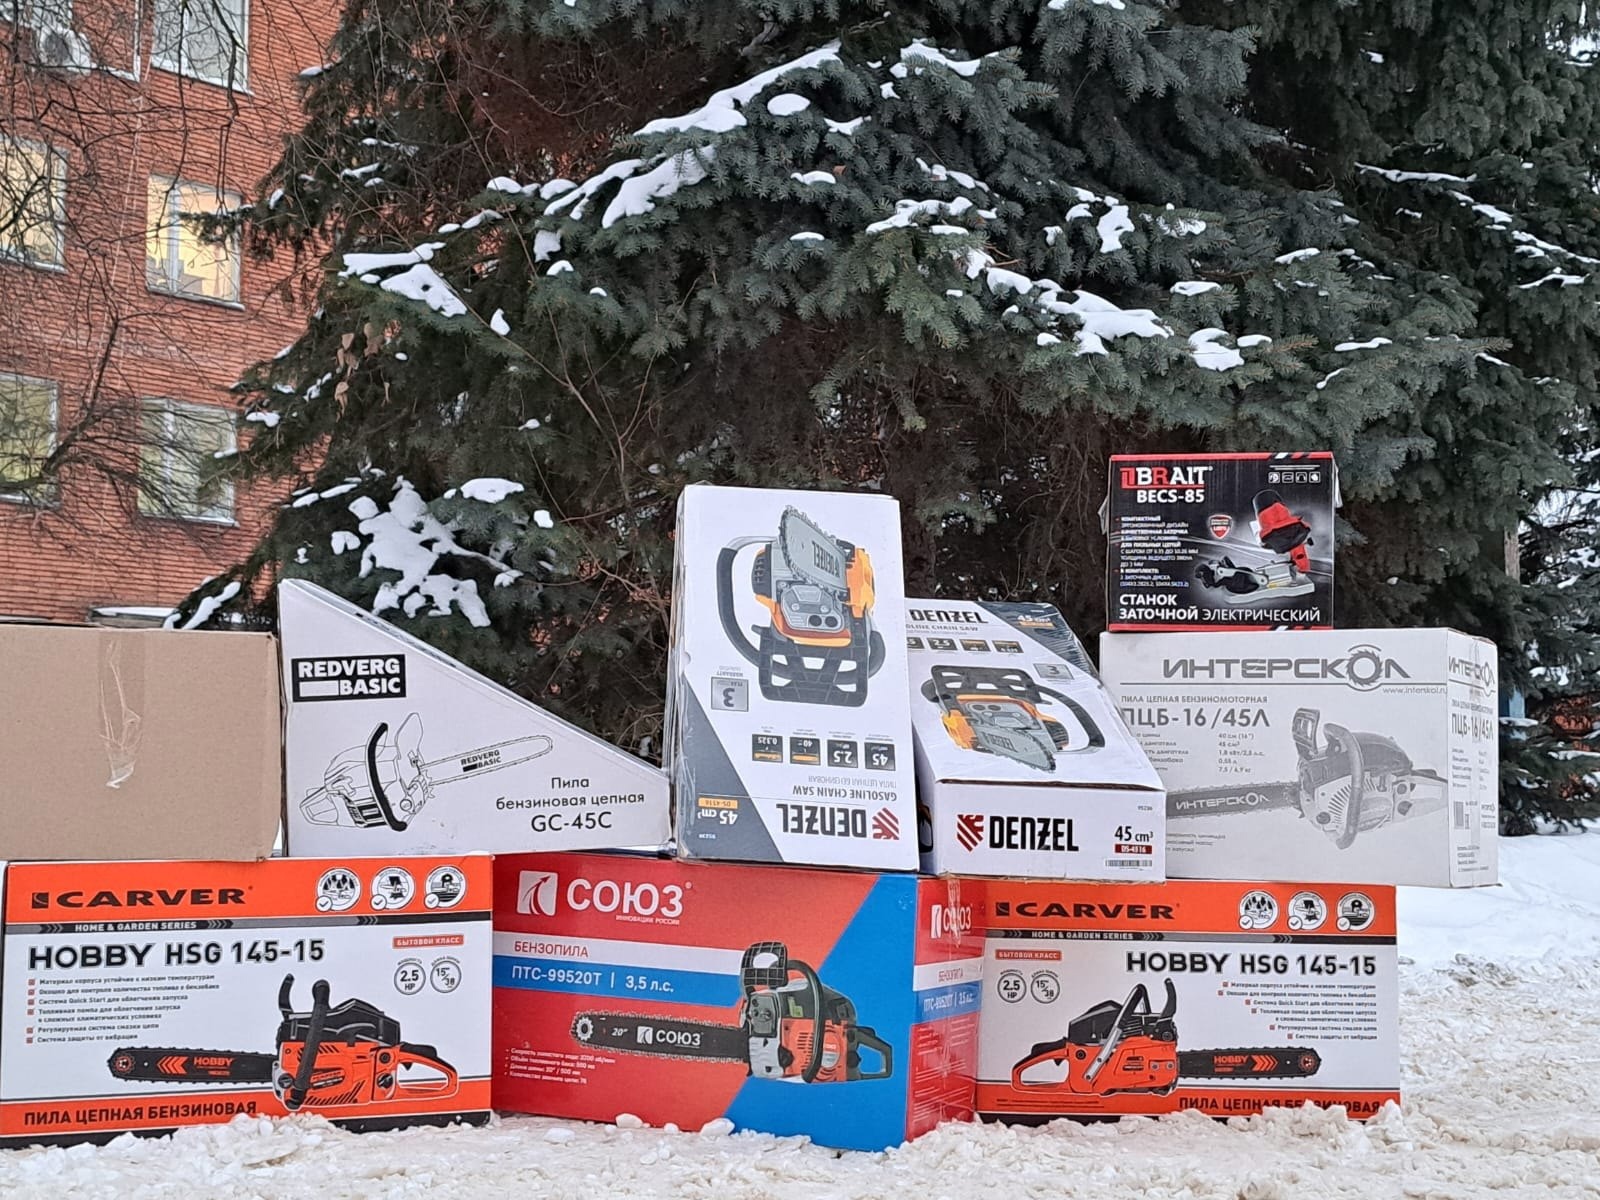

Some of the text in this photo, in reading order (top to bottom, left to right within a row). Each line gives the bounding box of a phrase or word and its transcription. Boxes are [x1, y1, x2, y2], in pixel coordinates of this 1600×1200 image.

[1137, 466, 1206, 485] BRAIT
[1136, 490, 1205, 503] BECS-85
[1119, 594, 1177, 606] СТАНОК
[908, 609, 989, 624] DENZEL
[1119, 606, 1321, 622] ЗАТОЧНОЙ ЭЛЕКТРИЧЕСКИЙ
[298, 659, 400, 679] REDVERG
[1163, 650, 1410, 686] ИНТЕРСКОЛ
[339, 678, 401, 696] BASIC
[722, 687, 735, 708] 3
[1146, 696, 1180, 704] ЦЕПНАЯ
[1181, 696, 1268, 704] БЕНЗИНОМОТОРНАЯ
[461, 750, 500, 766] REDVERG
[477, 757, 501, 769] BASIC
[834, 750, 852, 764] 2.5
[872, 753, 889, 766] 45
[551, 776, 590, 789] Пила
[496, 791, 645, 810] бензиновая цепная
[793, 785, 897, 802] GASOLINE CHAIN SAW
[1176, 792, 1269, 810] ИНТЕРСКОЛ
[531, 812, 612, 832] GC-45C
[719, 811, 738, 825] 45
[776, 803, 867, 838] DENZEL
[989, 816, 1079, 851] DENZEL
[1114, 826, 1132, 841] 45
[57, 888, 247, 908] CARVER
[566, 878, 683, 918] СОЮЗ
[1016, 902, 1175, 919] CARVER
[75, 921, 197, 932] HOME & GARDEN SERIES
[1031, 931, 1134, 940] HOME & GARDEN SERIES
[28, 938, 324, 971] HOBBY HSG 145-15
[514, 940, 589, 958] БЕНЗОПИЛА
[1125, 951, 1377, 977] HOBBY HSG 145-15
[400, 970, 419, 982] 2.5
[511, 965, 675, 993] ПТС-99520Т 3,5 л.с.
[404, 983, 415, 991] HP
[1003, 980, 1020, 992] 2.5
[656, 1029, 701, 1046] СОЮЗ
[193, 1056, 235, 1067] HOBBY
[1213, 1055, 1249, 1064] HOBBY
[1179, 1097, 1220, 1110] ПИЛА
[24, 1101, 257, 1126] ПИЛА ЦЕПНАЯ БЕНЗИНОВАЯ
